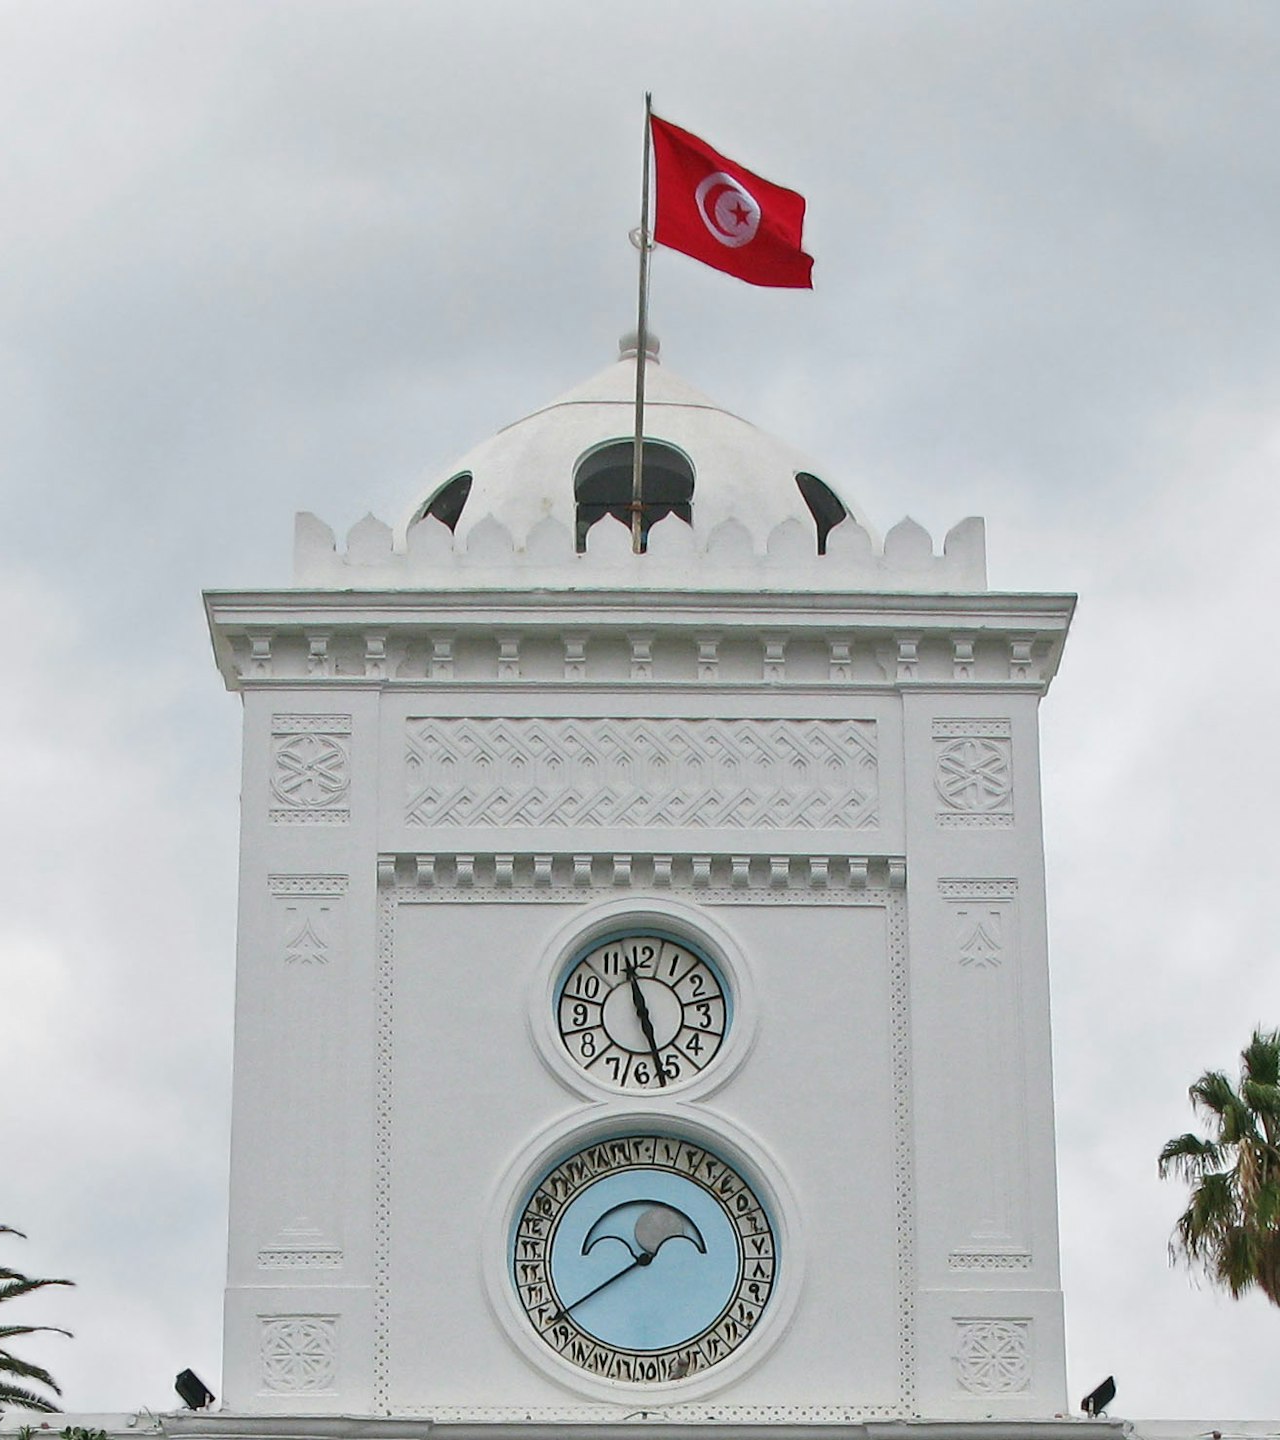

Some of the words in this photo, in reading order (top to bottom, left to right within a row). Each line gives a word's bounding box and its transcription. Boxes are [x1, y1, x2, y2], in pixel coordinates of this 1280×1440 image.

[604, 952, 618, 975] 11
[633, 946, 654, 968] 12
[669, 953, 679, 976] 1
[575, 974, 599, 998] 10
[689, 974, 705, 997] 2
[573, 1003, 588, 1026] 9
[696, 1003, 712, 1028] 3
[581, 1032, 595, 1057] 8
[686, 1033, 704, 1056] 4
[605, 1057, 620, 1080] 7
[634, 1062, 649, 1085] 6
[666, 1055, 680, 1079] 5
